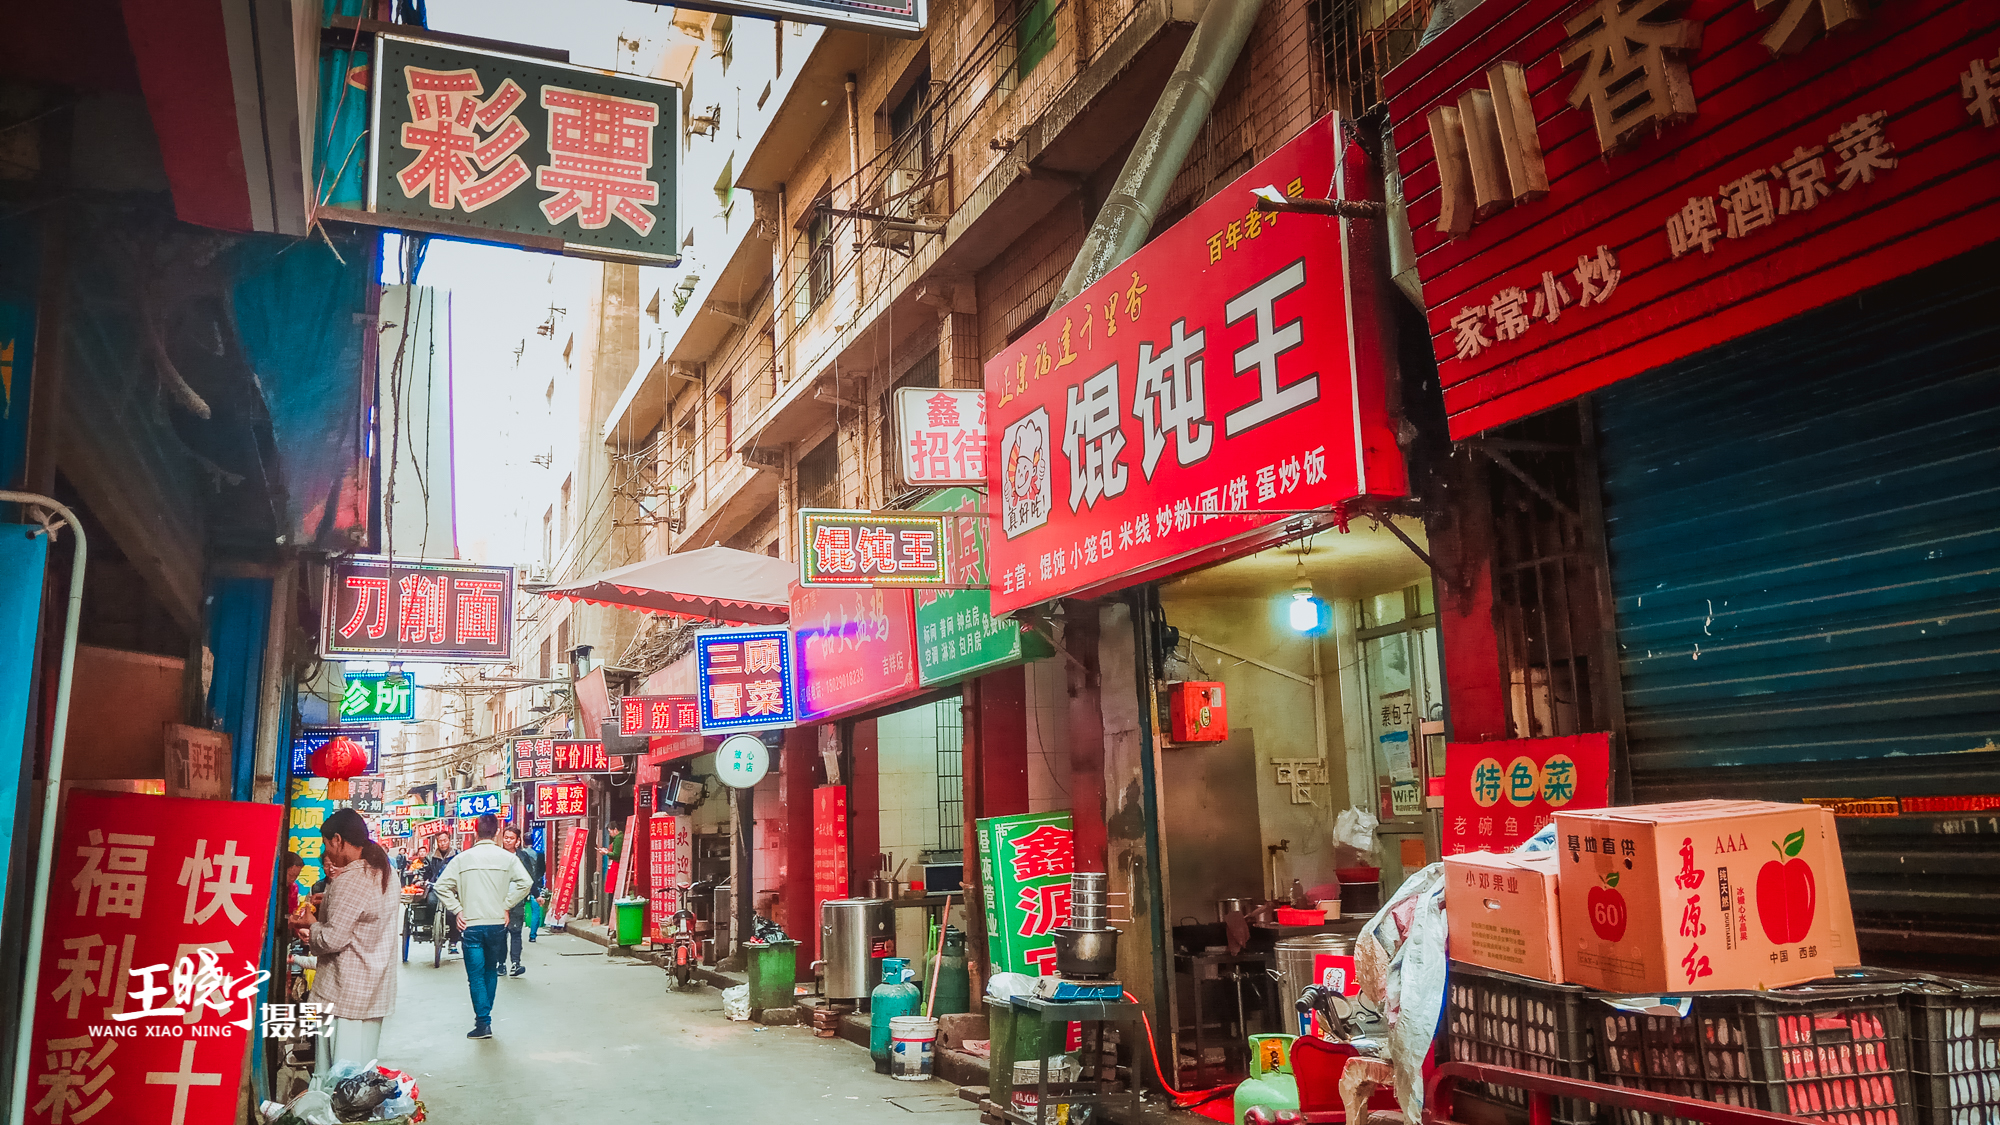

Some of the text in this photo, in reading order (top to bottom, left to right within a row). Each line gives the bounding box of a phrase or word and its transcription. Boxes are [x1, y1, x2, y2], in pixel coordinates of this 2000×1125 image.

[396, 64, 660, 237] 彩票
[1449, 244, 1622, 360] 家常小炒
[1665, 110, 1898, 259] 啤酒凉菜
[1061, 257, 1320, 516] 馄饨王
[1040, 547, 1066, 583] 馄饨
[1070, 530, 1115, 570] 小笼包
[1118, 512, 1152, 551] 米线
[1256, 445, 1327, 504] 蛋炒饭
[813, 525, 938, 574] 馄饨王
[339, 573, 503, 645] 刀削面
[956, 605, 980, 632] 钟点房
[706, 638, 783, 676] 三顾
[959, 630, 982, 657] 包月房
[882, 651, 904, 676] 吉祥店
[340, 679, 411, 716] 诊所
[709, 680, 784, 720] 冒菜
[625, 702, 696, 731] 削筋面
[1380, 703, 1412, 727] 素包子
[515, 739, 552, 758] 香锅
[554, 744, 607, 769] 平价川菜
[516, 758, 552, 779] 冒菜
[1475, 760, 1574, 802] 特色菜
[461, 794, 499, 815] 纸包鱼
[1567, 834, 1636, 857] 基地直供
[1714, 832, 1749, 855] AAA
[979, 829, 999, 938] 昼夜营业
[1465, 870, 1519, 895] 小邓果业
[1594, 902, 1619, 926] 60
[1675, 837, 1714, 986] 高原红
[1769, 944, 1818, 964] 中国 西部
